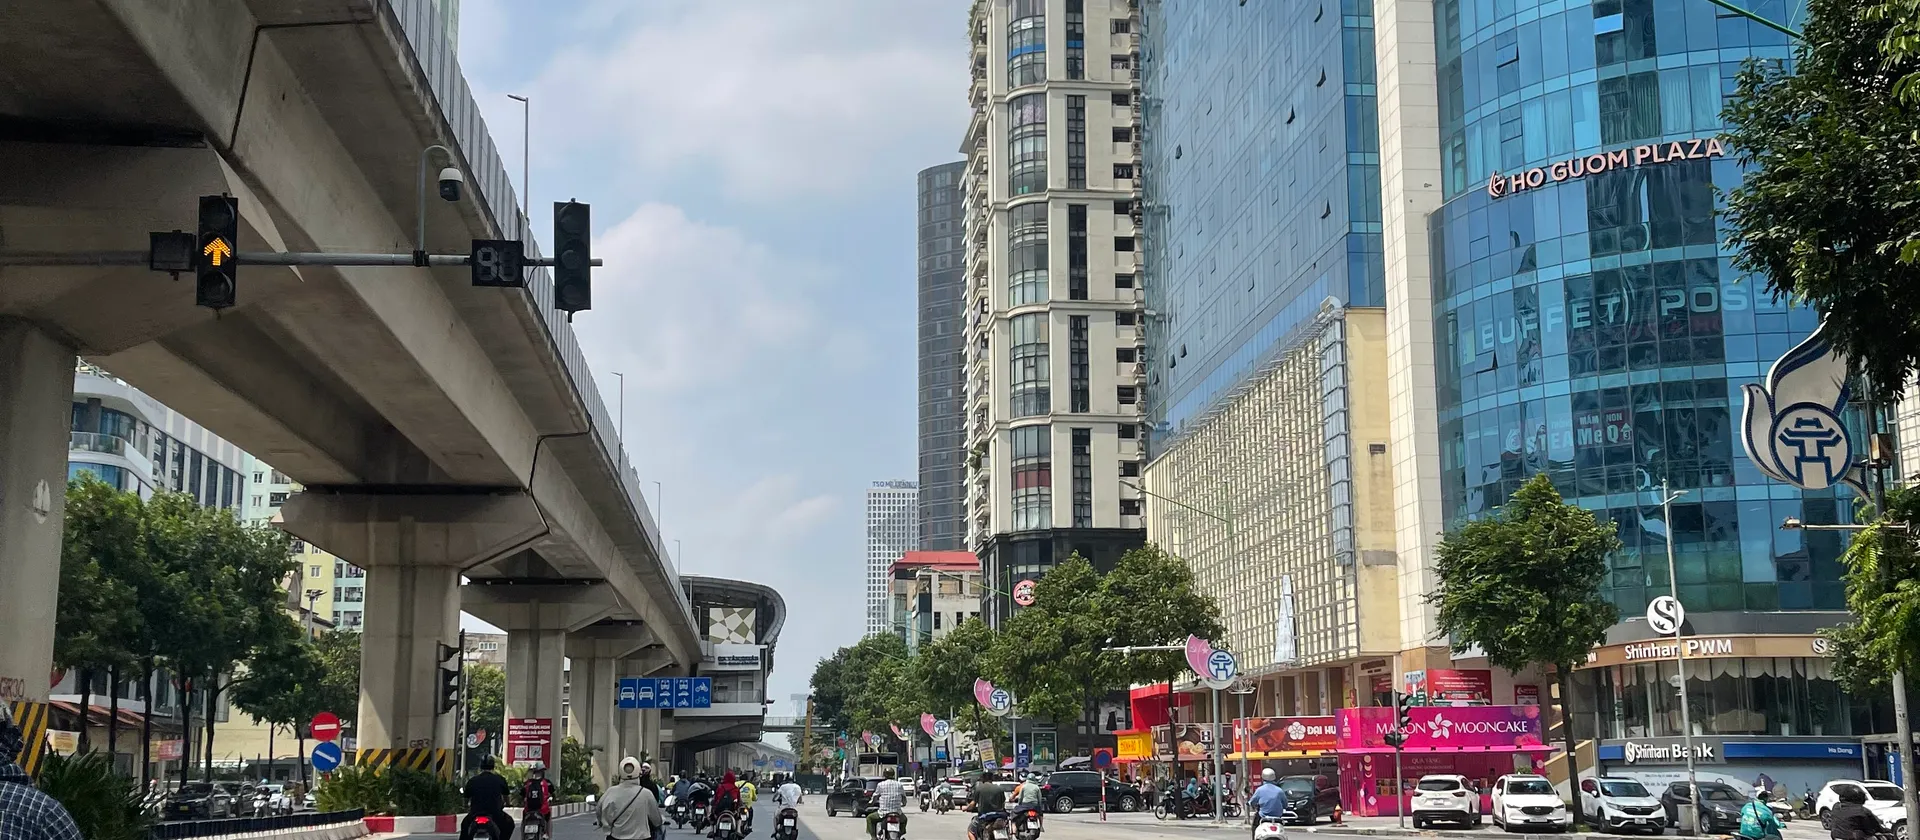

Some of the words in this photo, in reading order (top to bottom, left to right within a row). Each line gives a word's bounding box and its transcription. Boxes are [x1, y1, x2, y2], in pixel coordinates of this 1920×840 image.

[1511, 167, 1545, 193] HO
[1551, 148, 1628, 182] GUOM
[1634, 137, 1724, 166] PLAZA
[1481, 297, 1621, 351] BUFFET
[1606, 412, 1623, 422] NON
[1625, 642, 1679, 660] Shinhan
[1686, 639, 1733, 655] PWM
[1307, 725, 1323, 737] ĐẠI
[1376, 722, 1426, 734] MASON
[1454, 720, 1528, 734] MOONCAKE
[1018, 743, 1027, 753] P
[1635, 743, 1670, 759] Shinhan
[955, 759, 963, 767] P
